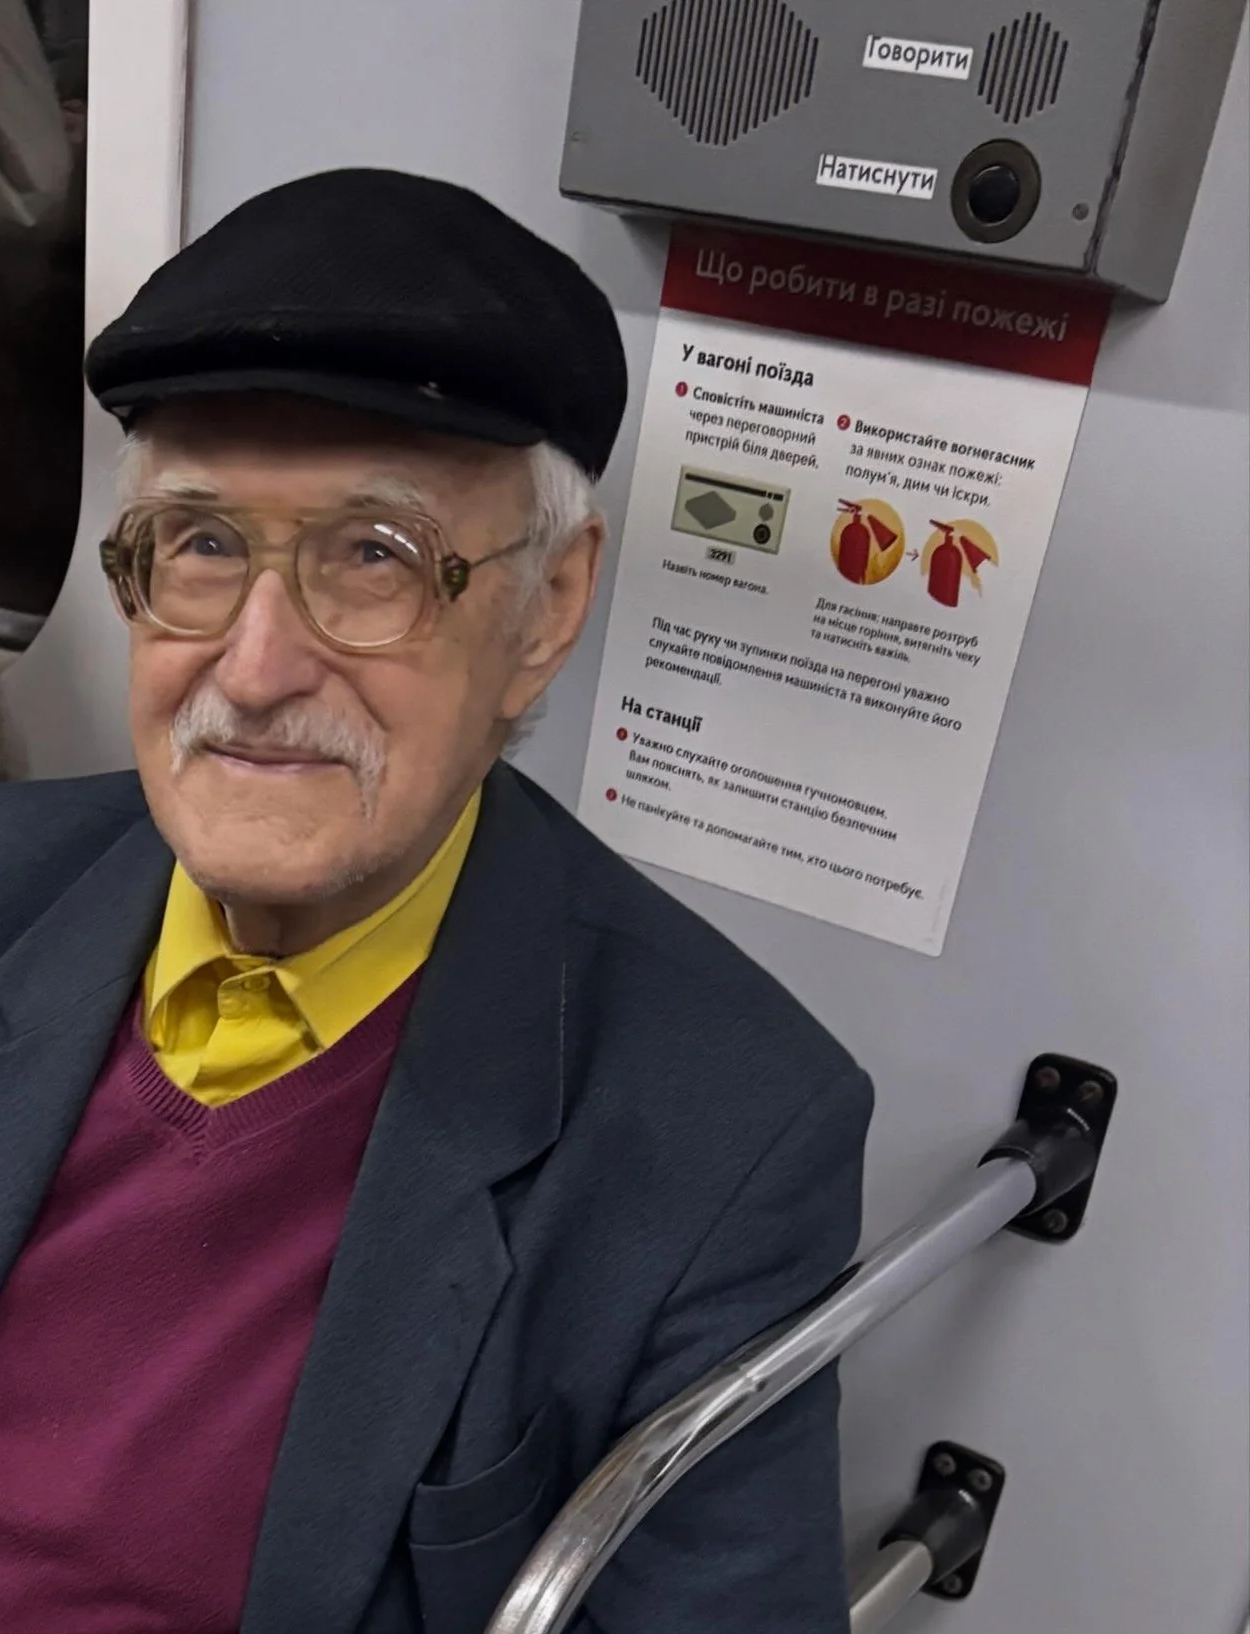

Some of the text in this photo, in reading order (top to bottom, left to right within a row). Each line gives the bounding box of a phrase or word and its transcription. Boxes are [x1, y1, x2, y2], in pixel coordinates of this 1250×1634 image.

[868, 36, 969, 71] Говорити
[820, 154, 934, 194] Натиснути
[696, 249, 1069, 341] Що робити в разі пожежі
[681, 343, 814, 388] У вагоні поїзда
[692, 385, 756, 411] Сповістіть
[757, 402, 825, 425] машиніста
[684, 429, 740, 452] пристрій
[741, 438, 769, 457] біля
[688, 409, 817, 446] через переговорний
[853, 419, 949, 452] Використайте
[949, 441, 1036, 470] вогнегасник
[849, 443, 864, 457] за
[865, 446, 906, 465] явних
[907, 455, 946, 474] ознак
[901, 476, 931, 493] дим
[932, 483, 950, 497] чи
[810, 628, 822, 640] та
[822, 632, 874, 653] натисніть
[814, 596, 838, 612] Для
[880, 615, 932, 636] направте
[930, 627, 979, 649] розтруб
[651, 616, 950, 707] Під час руку чи зупинки поїзда на перегоні уважно
[648, 637, 963, 732] слухайте повідомлення машиніста та виконуйте його
[620, 695, 704, 733] На станції
[632, 731, 674, 755] Уважно
[674, 747, 729, 772] слухайте
[729, 763, 803, 793] оголошення
[628, 748, 651, 766] Вам
[707, 775, 721, 787] як
[722, 779, 779, 805] залишити
[780, 797, 829, 821] станцію
[830, 810, 898, 841] безпечним
[620, 793, 637, 809] Не
[637, 800, 691, 826] панікуйте
[692, 817, 705, 830] та
[704, 822, 779, 854] допомагайте
[805, 854, 828, 869] хто
[828, 861, 864, 881] цього
